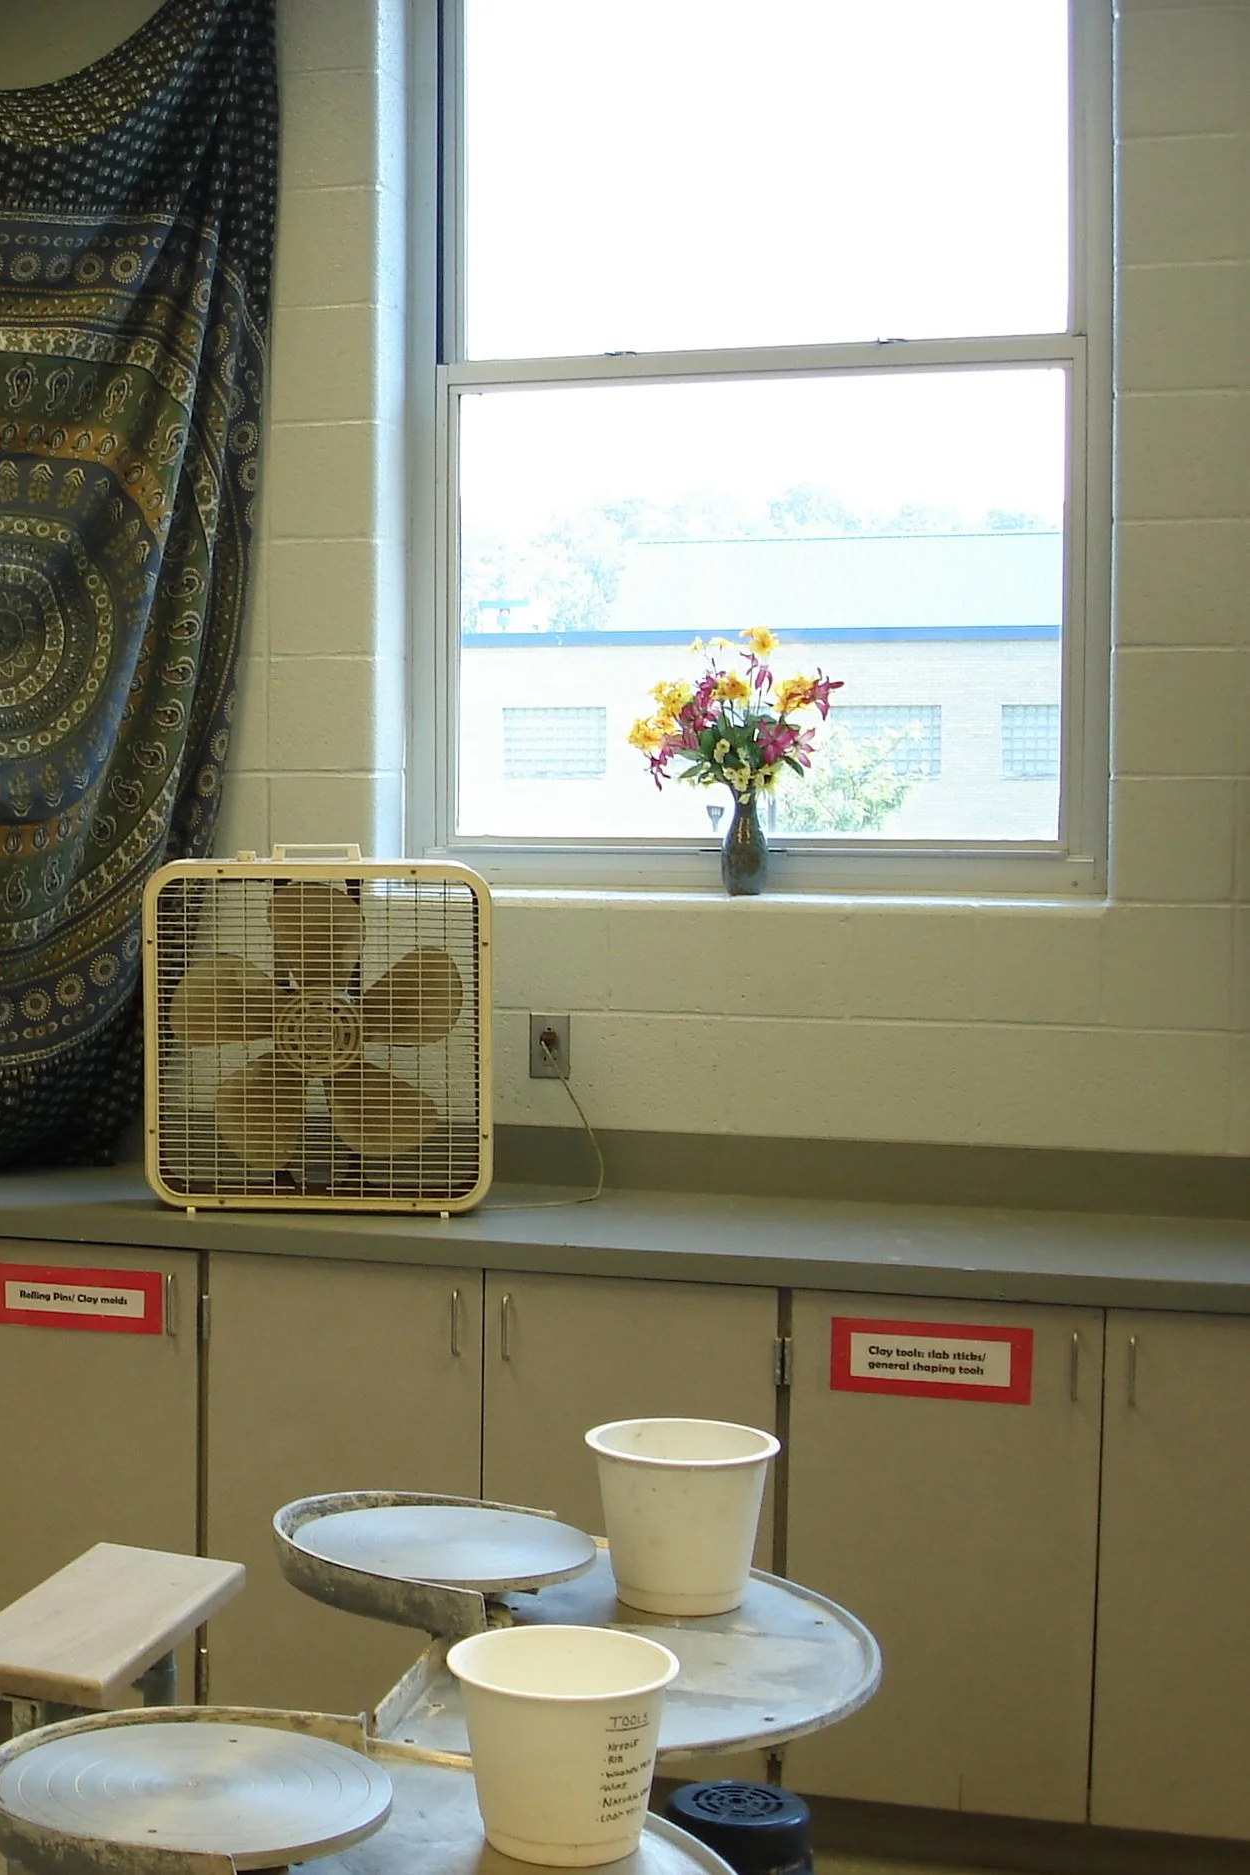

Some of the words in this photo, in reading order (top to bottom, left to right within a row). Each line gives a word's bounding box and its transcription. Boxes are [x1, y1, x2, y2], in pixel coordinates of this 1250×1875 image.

[19, 1290, 51, 1302] Rolling
[77, 1294, 99, 1305] Clay
[100, 1297, 128, 1305] molds
[868, 1346, 894, 1357] Clay
[896, 1349, 925, 1359] tools:
[927, 1351, 950, 1360] slab
[868, 1360, 910, 1371] general
[912, 1363, 956, 1376] shaping
[958, 1366, 984, 1375] tools
[610, 1712, 649, 1729] TOOLS
[607, 1739, 639, 1752] NEEDLE
